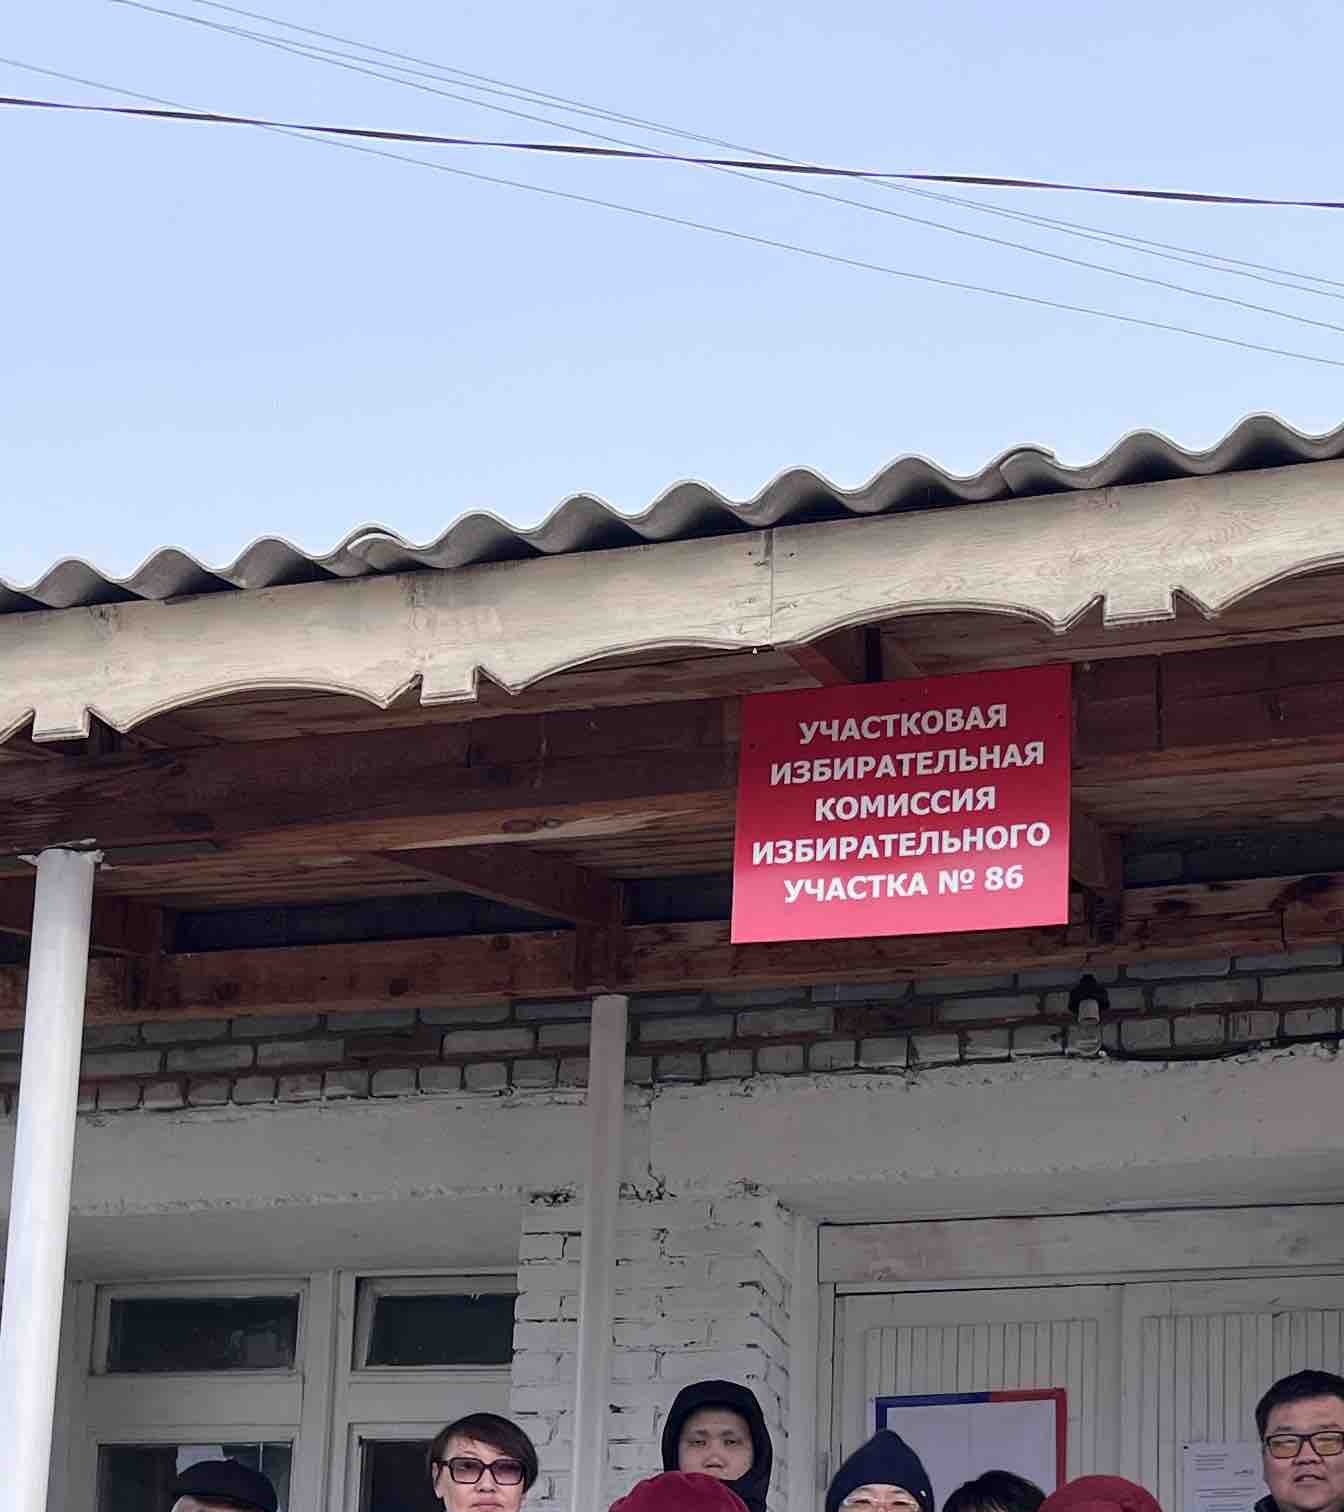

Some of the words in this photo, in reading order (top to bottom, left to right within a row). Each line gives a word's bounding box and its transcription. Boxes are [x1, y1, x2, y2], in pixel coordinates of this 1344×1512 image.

[799, 704, 1007, 745] УЧАСТКОВАЯ
[770, 741, 1045, 786] ИЗБИРАТЕЛЬНАЯ
[815, 786, 996, 822] КОМИССИЯ
[752, 822, 1051, 865] ИЗБИРАТЕЛЬНОГО
[783, 872, 928, 903] УЧАСТКА
[938, 868, 976, 893] №
[984, 865, 1024, 891] 86
